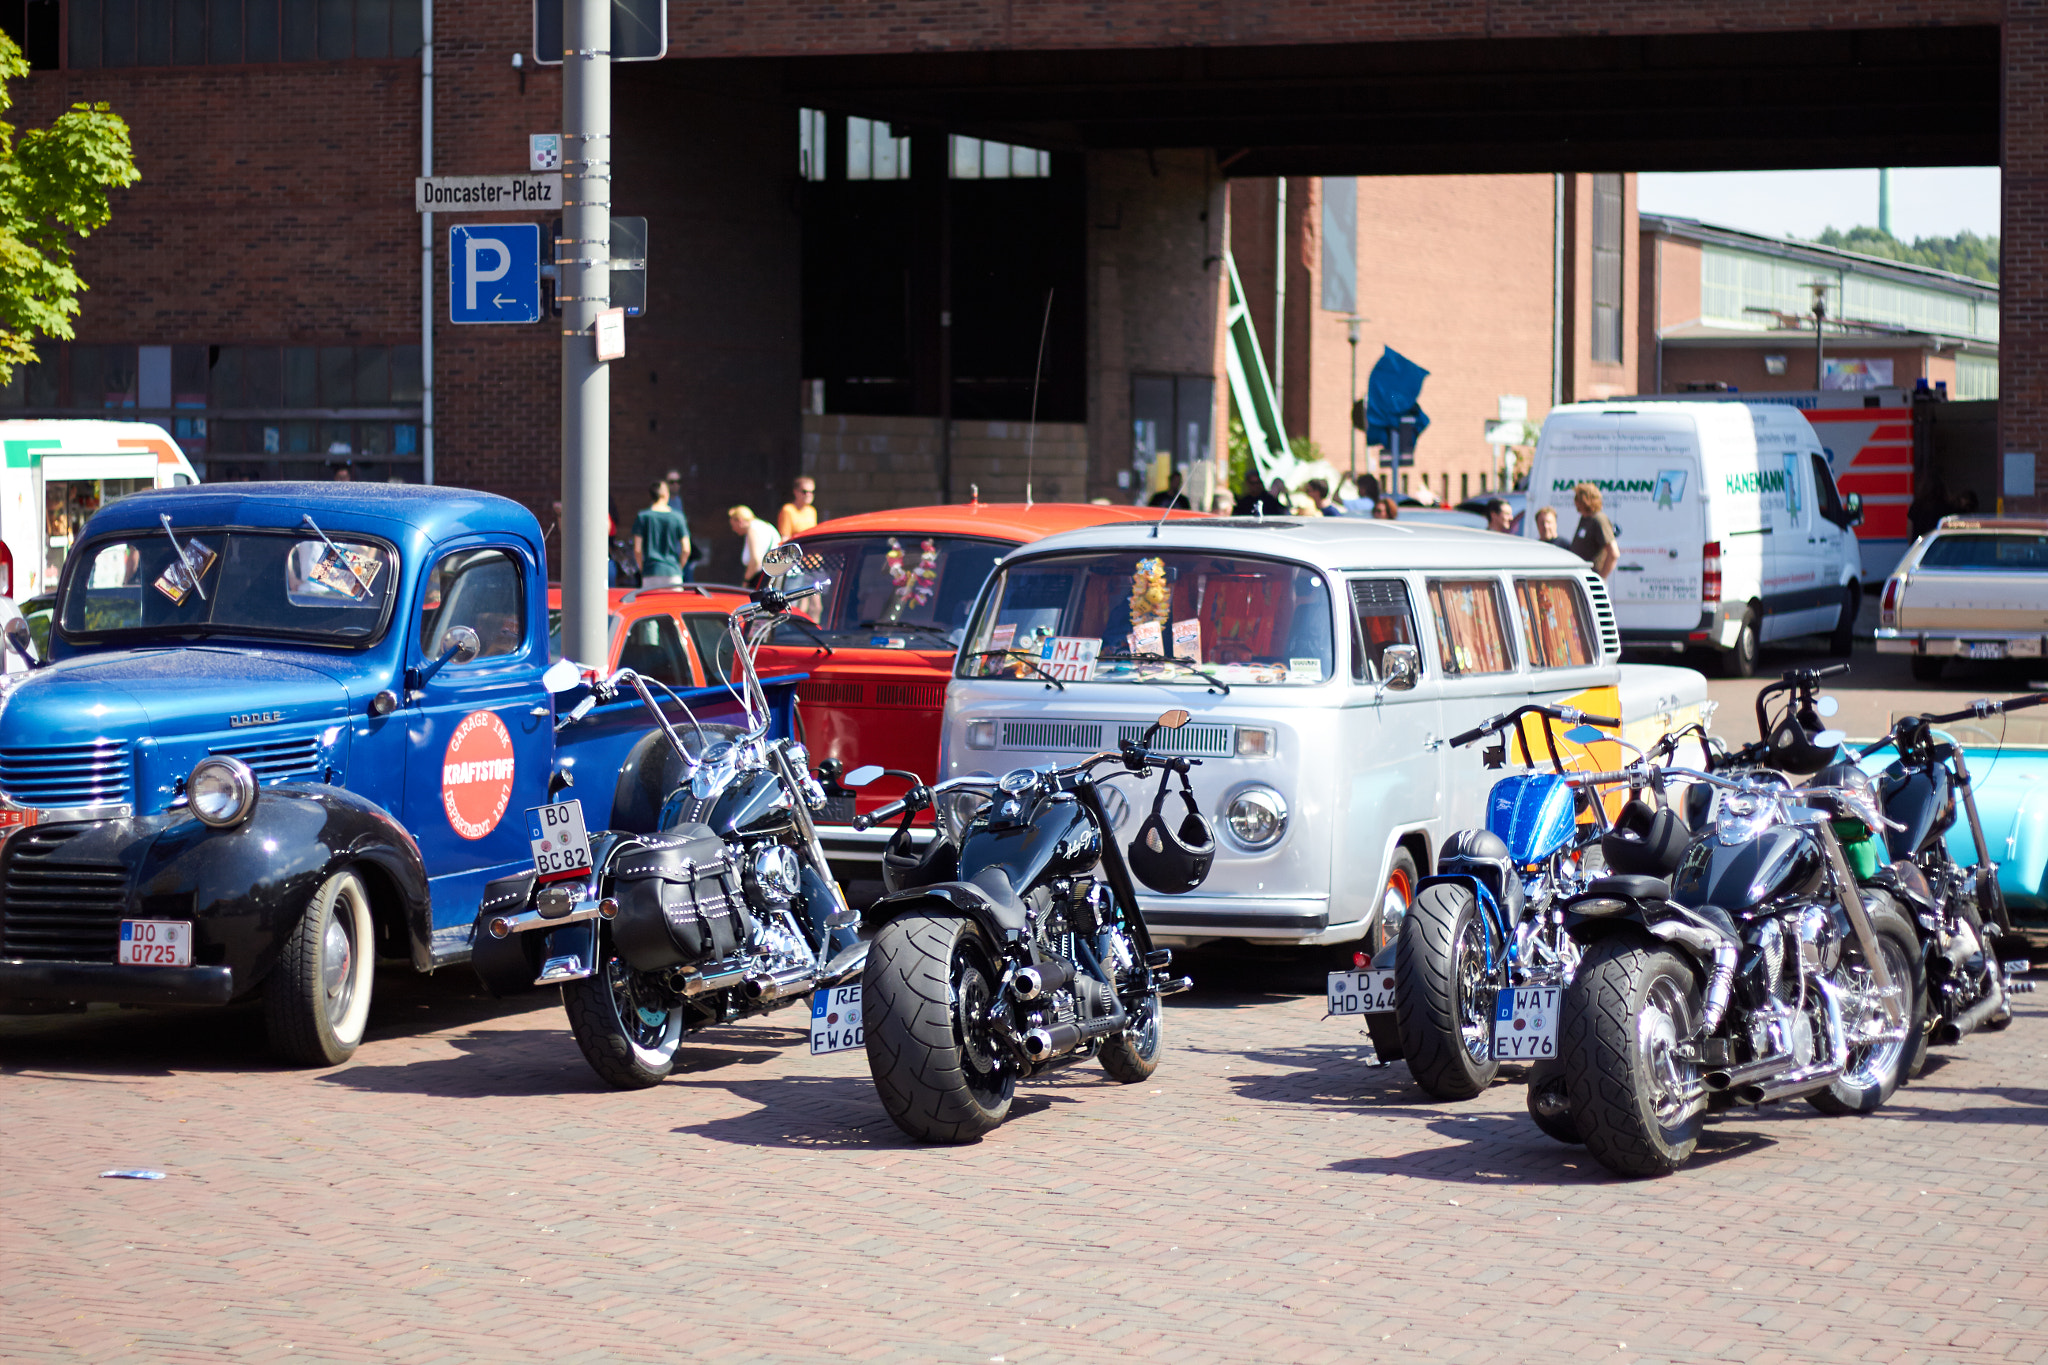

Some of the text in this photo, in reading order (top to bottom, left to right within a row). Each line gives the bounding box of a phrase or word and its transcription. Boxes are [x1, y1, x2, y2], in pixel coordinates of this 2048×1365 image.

[424, 180, 552, 203] Doncaster-Platz
[465, 238, 511, 310] P
[1552, 478, 1655, 493] HAMANN
[1726, 469, 1785, 495] HANEMANN
[1054, 640, 1081, 661] MI
[229, 711, 281, 728] DODGE
[451, 713, 510, 752] GARAGE INK
[443, 758, 515, 785] KRAFTSTOFF
[445, 783, 511, 837] DEPARTMENT 1947
[545, 805, 569, 827] BO
[537, 847, 588, 873] BC 82
[133, 923, 156, 942] DO
[132, 944, 176, 963] 0725
[1358, 973, 1370, 991] D
[835, 986, 862, 1006] RE
[1331, 994, 1358, 1012] HD
[1516, 990, 1557, 1010] WAT
[814, 1030, 839, 1051] FW
[1496, 1035, 1552, 1056] EY 76
